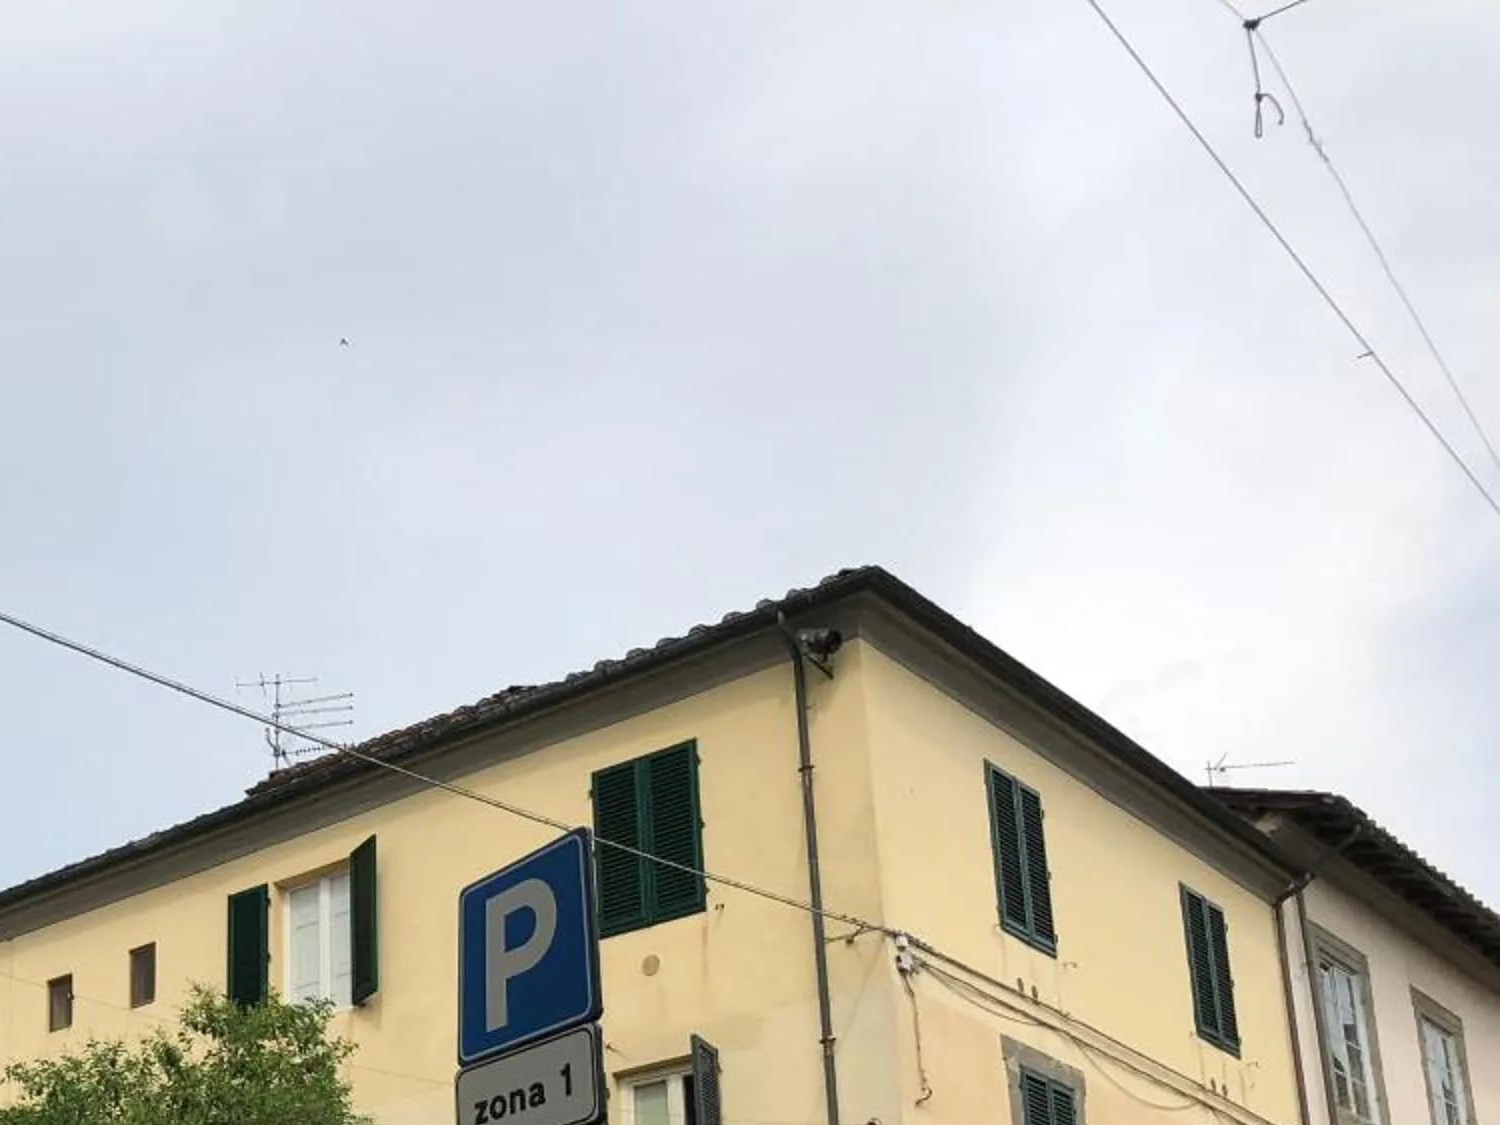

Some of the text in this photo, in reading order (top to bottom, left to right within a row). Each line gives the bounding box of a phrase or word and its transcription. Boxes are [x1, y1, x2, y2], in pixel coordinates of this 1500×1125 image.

[485, 878, 557, 1032] P
[474, 1063, 573, 1125] zona 1
